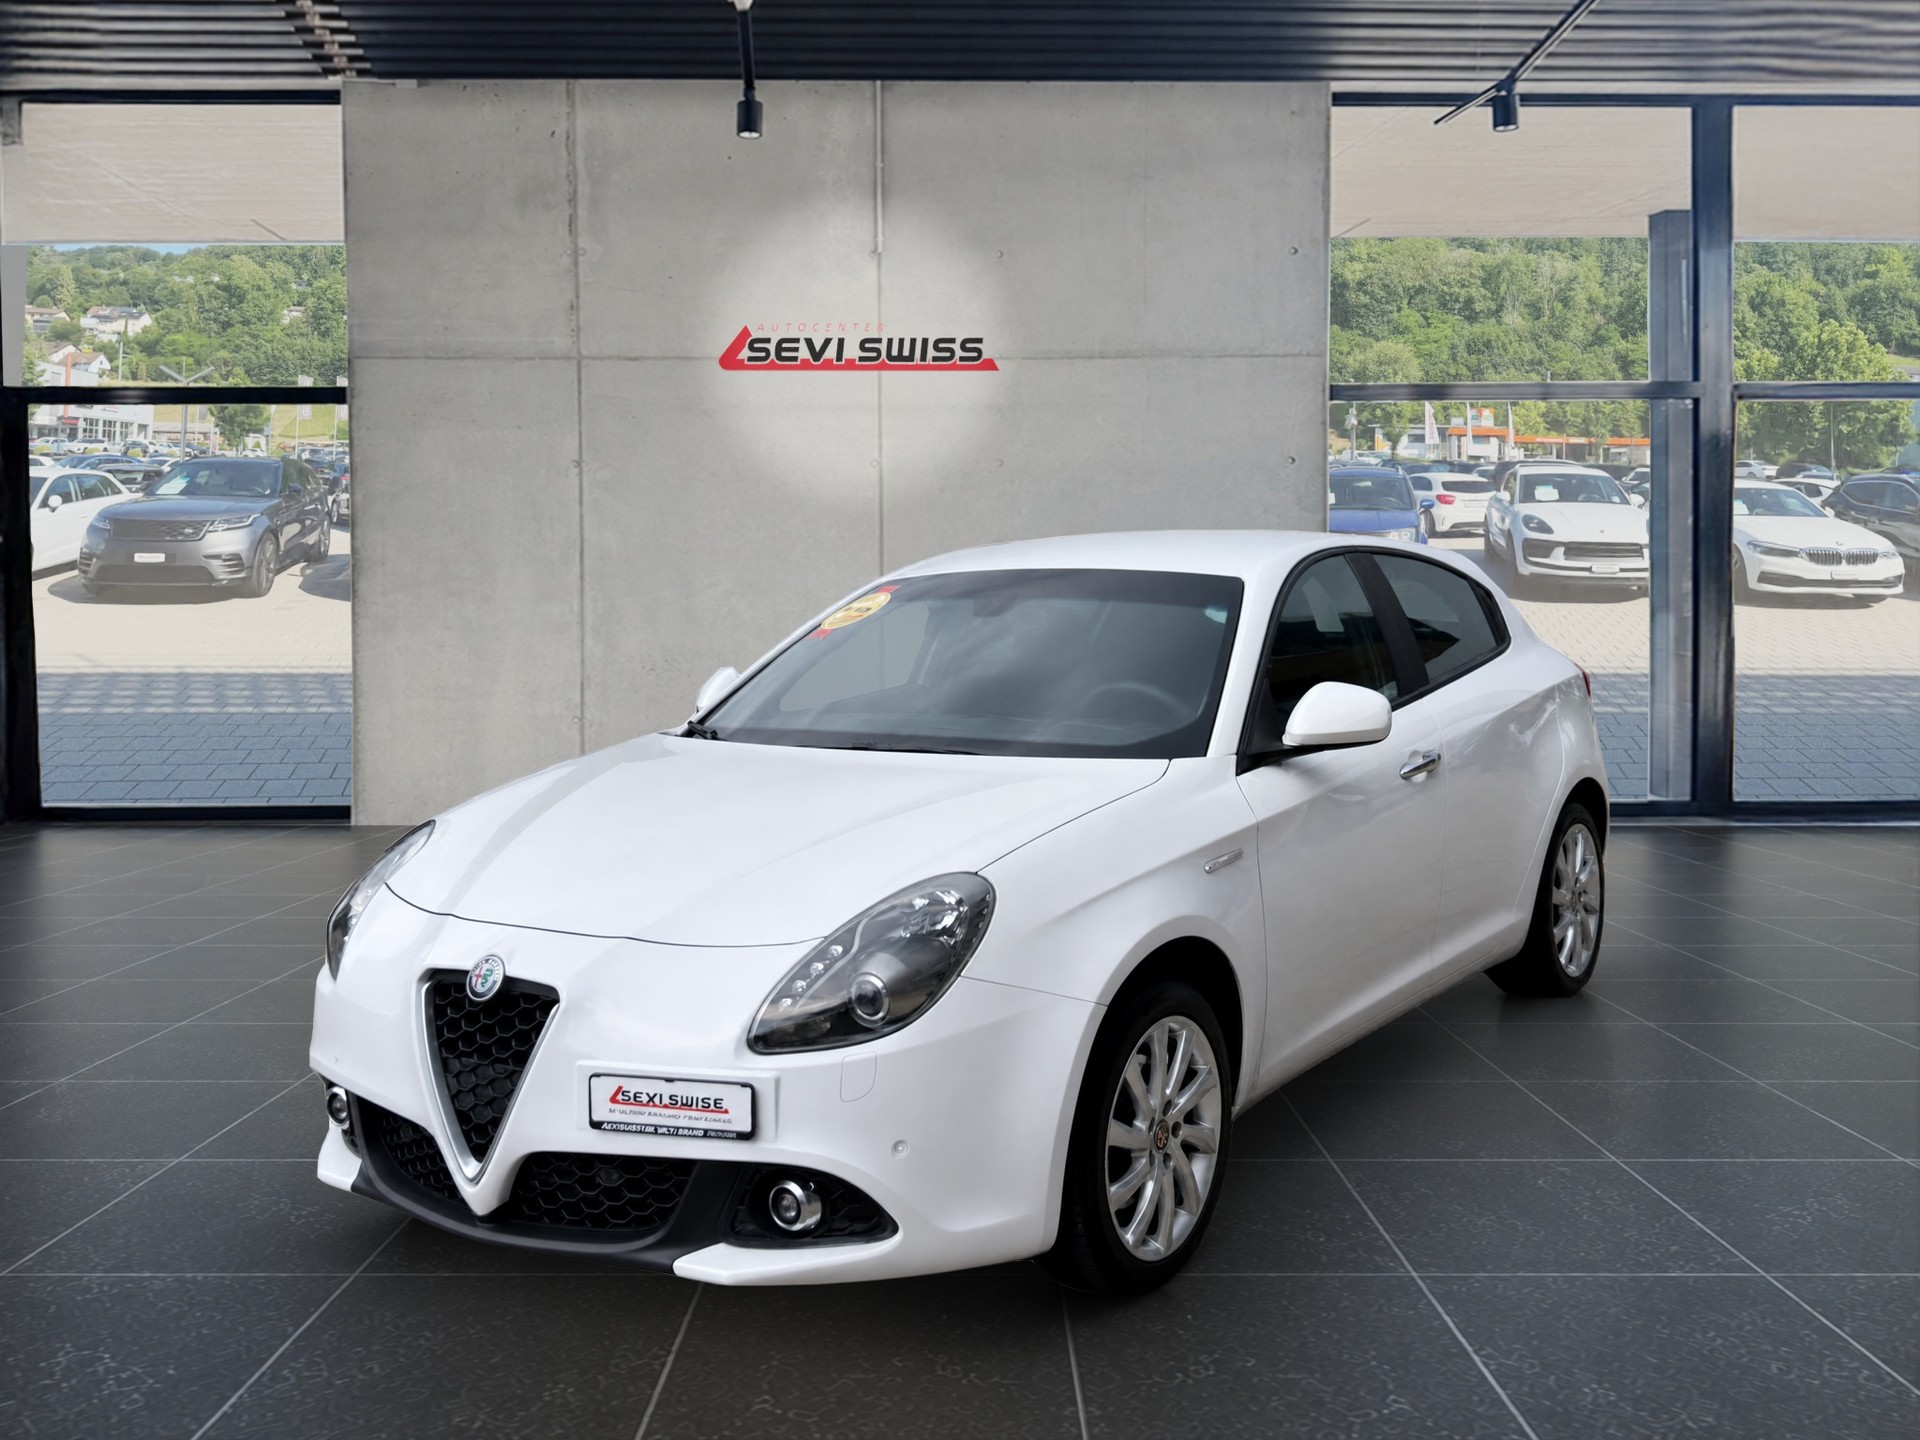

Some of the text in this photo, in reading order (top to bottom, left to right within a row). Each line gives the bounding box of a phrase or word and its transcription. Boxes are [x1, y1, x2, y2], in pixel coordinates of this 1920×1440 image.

[757, 323, 884, 333] AUTOCENTER
[747, 337, 983, 362] SEVI SWISS
[621, 1090, 724, 1109] SEXI SWISE
